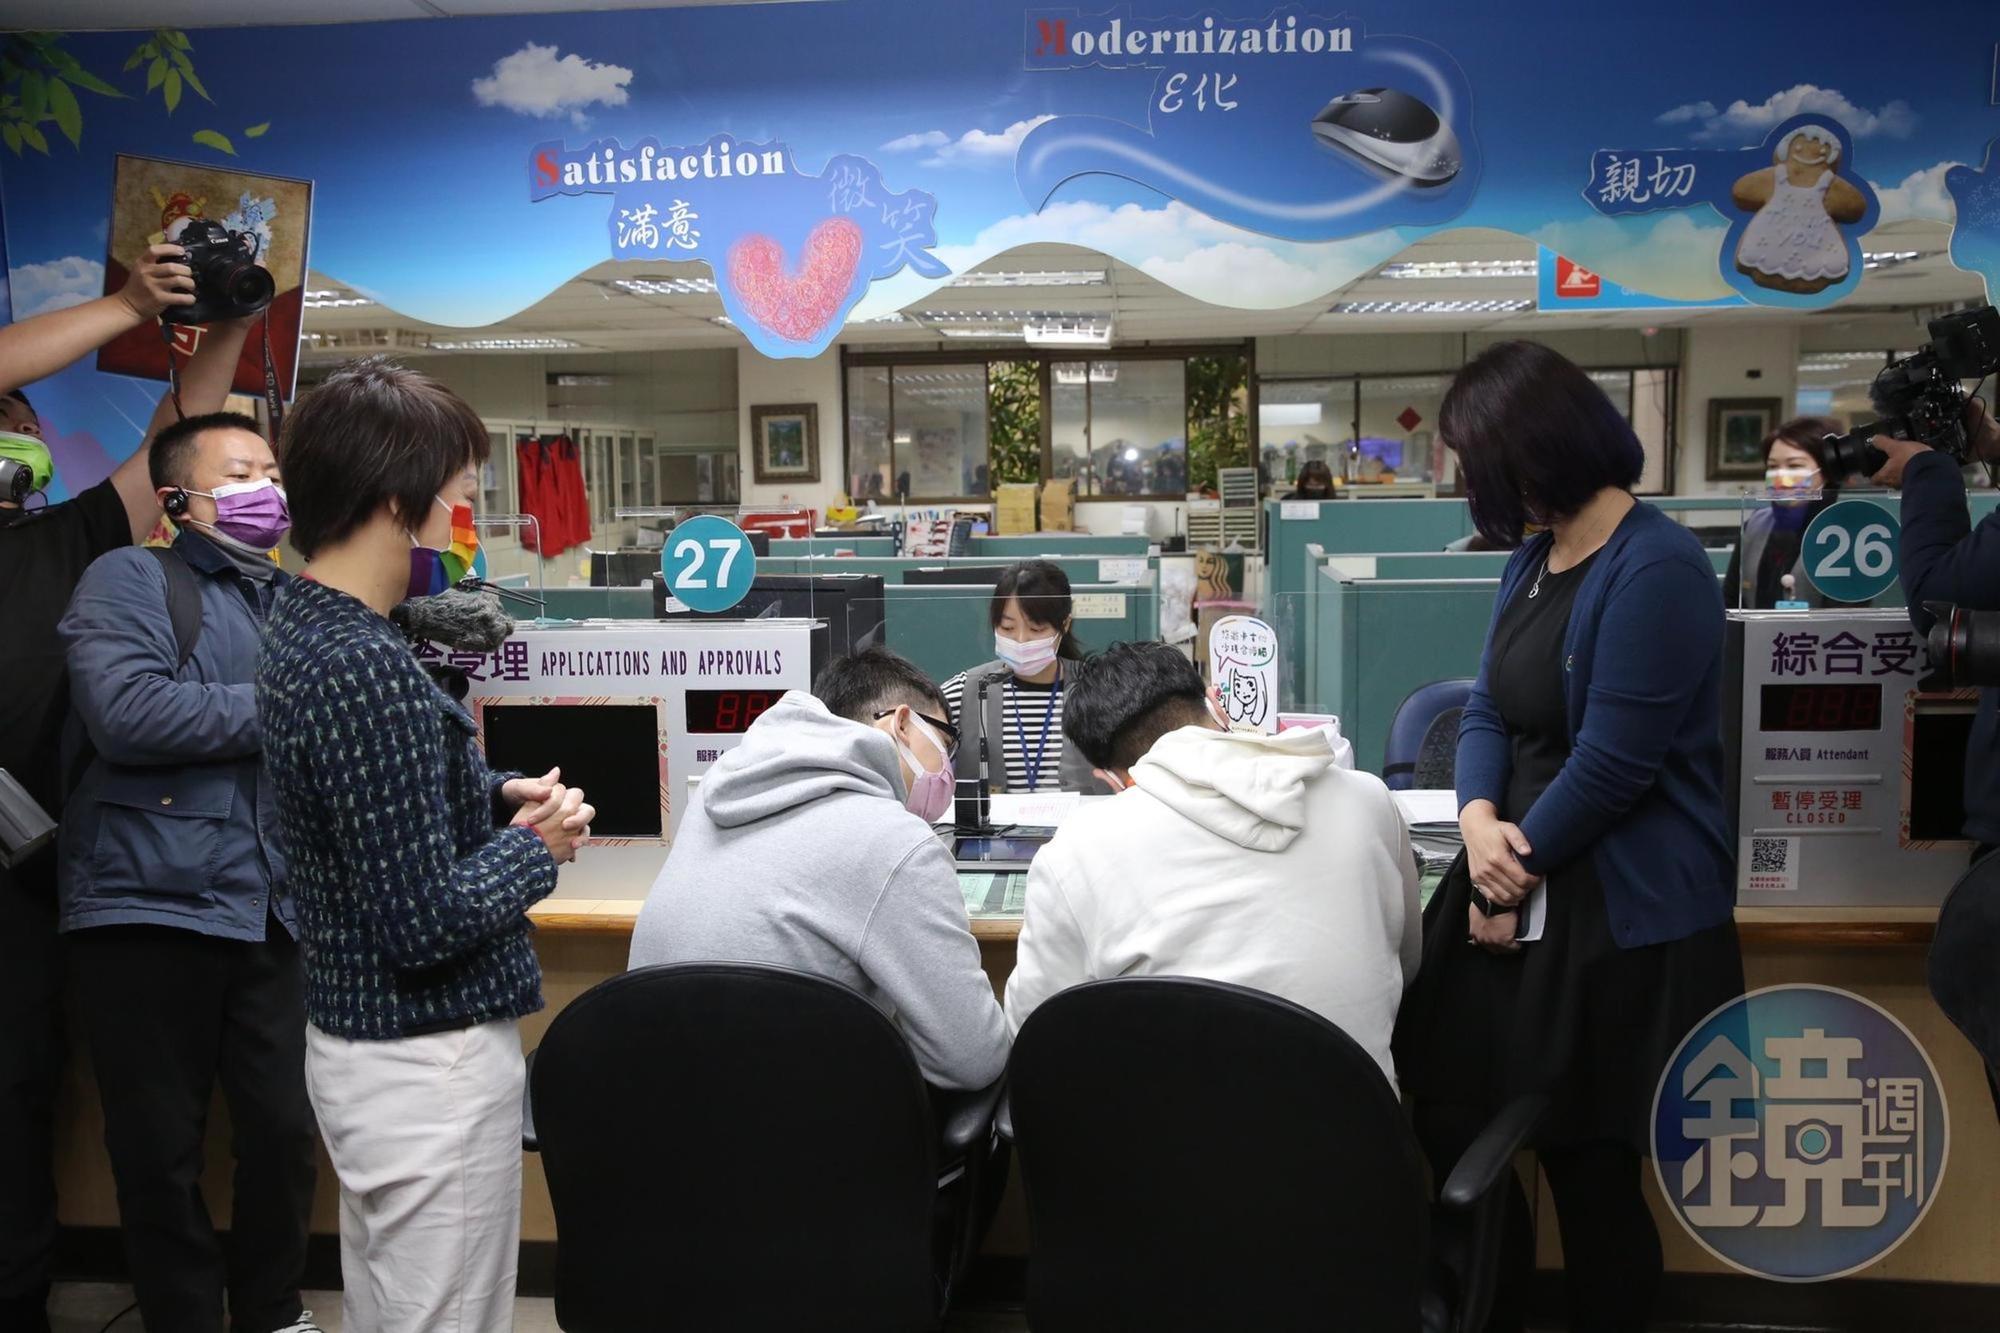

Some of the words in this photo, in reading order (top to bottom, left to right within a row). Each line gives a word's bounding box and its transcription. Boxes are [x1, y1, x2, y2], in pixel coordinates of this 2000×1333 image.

[1035, 15, 1353, 56] Modernization
[535, 142, 785, 189] Satisfaction
[1599, 155, 1696, 203] 親切
[617, 199, 700, 250] 滿意
[673, 538, 742, 589] 27
[1814, 524, 1893, 578] 26
[541, 652, 650, 677] APPLICATIONS
[660, 651, 687, 676] AND
[698, 649, 782, 676] APPROVALS
[1770, 631, 1934, 677] 綜合受
[1765, 747, 1811, 761] 服務人員
[1816, 748, 1869, 761] Attendant
[1771, 790, 1863, 812] 暫停受理
[1786, 812, 1846, 824] CLOSED
